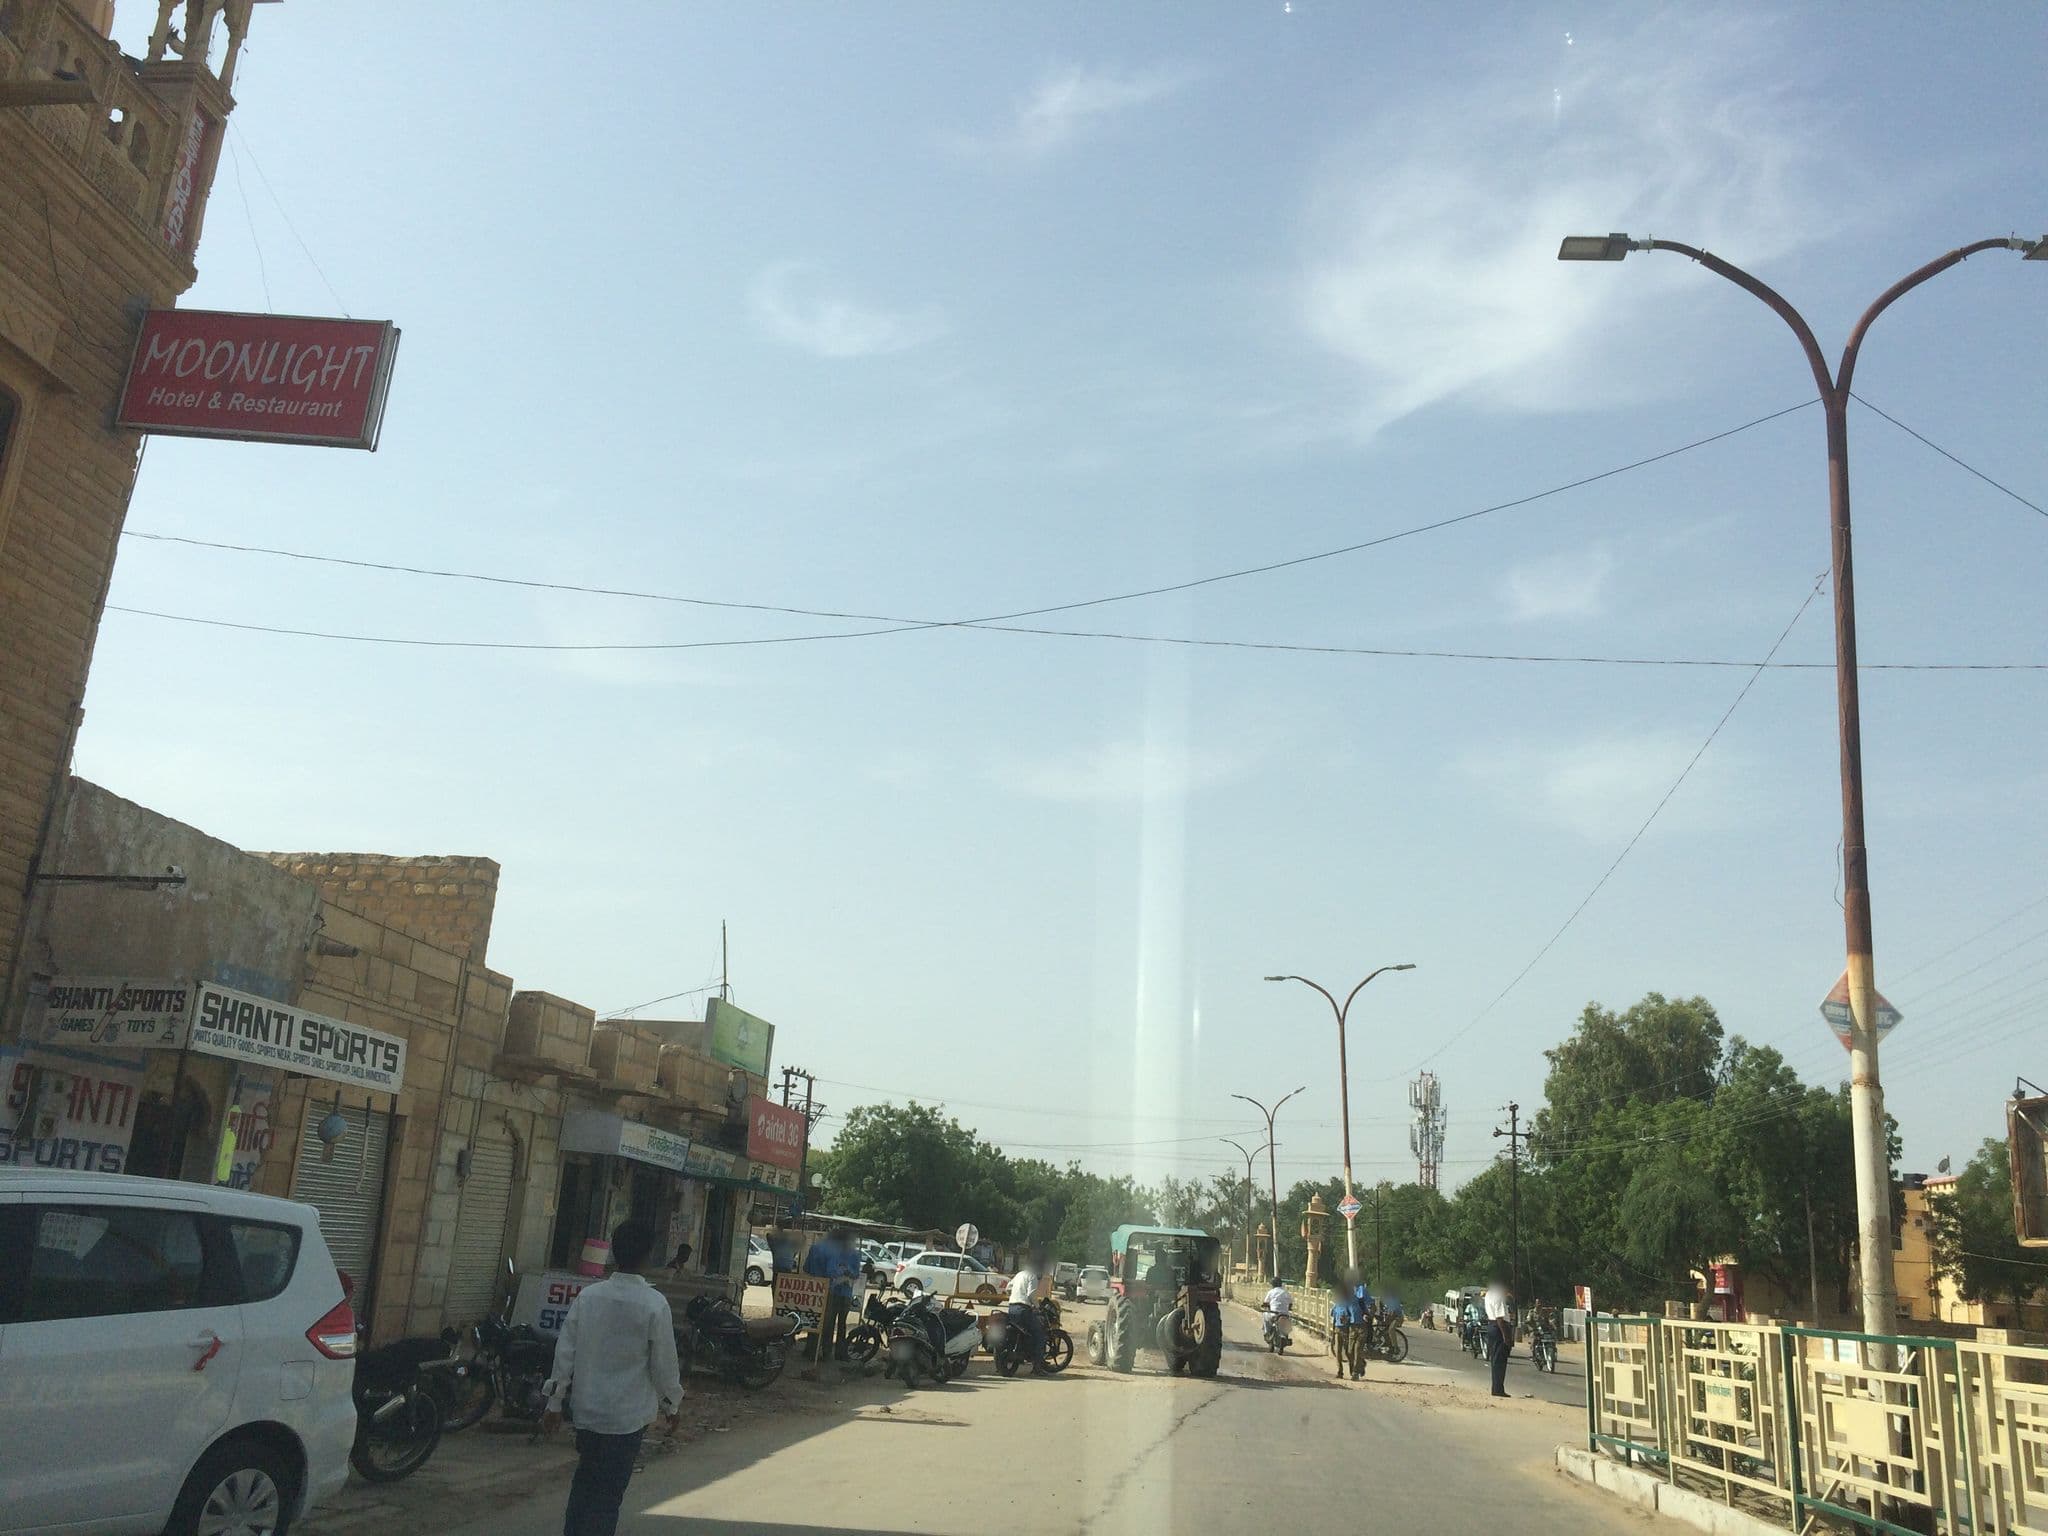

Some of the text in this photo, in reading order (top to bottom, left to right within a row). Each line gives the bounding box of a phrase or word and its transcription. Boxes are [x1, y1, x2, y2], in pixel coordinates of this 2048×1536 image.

[140, 333, 375, 393] MOONLIGHT
[147, 386, 343, 418] Hotel & Restaurant
[49, 986, 187, 1014] SHANTI SPORTS
[199, 991, 400, 1074] SHANTI SPORTS
[9, 1064, 135, 1128] SANTI
[765, 1117, 800, 1148] airtel 3G
[777, 1290, 825, 1308] SPORTS
[779, 1278, 825, 1294] INDIAN
